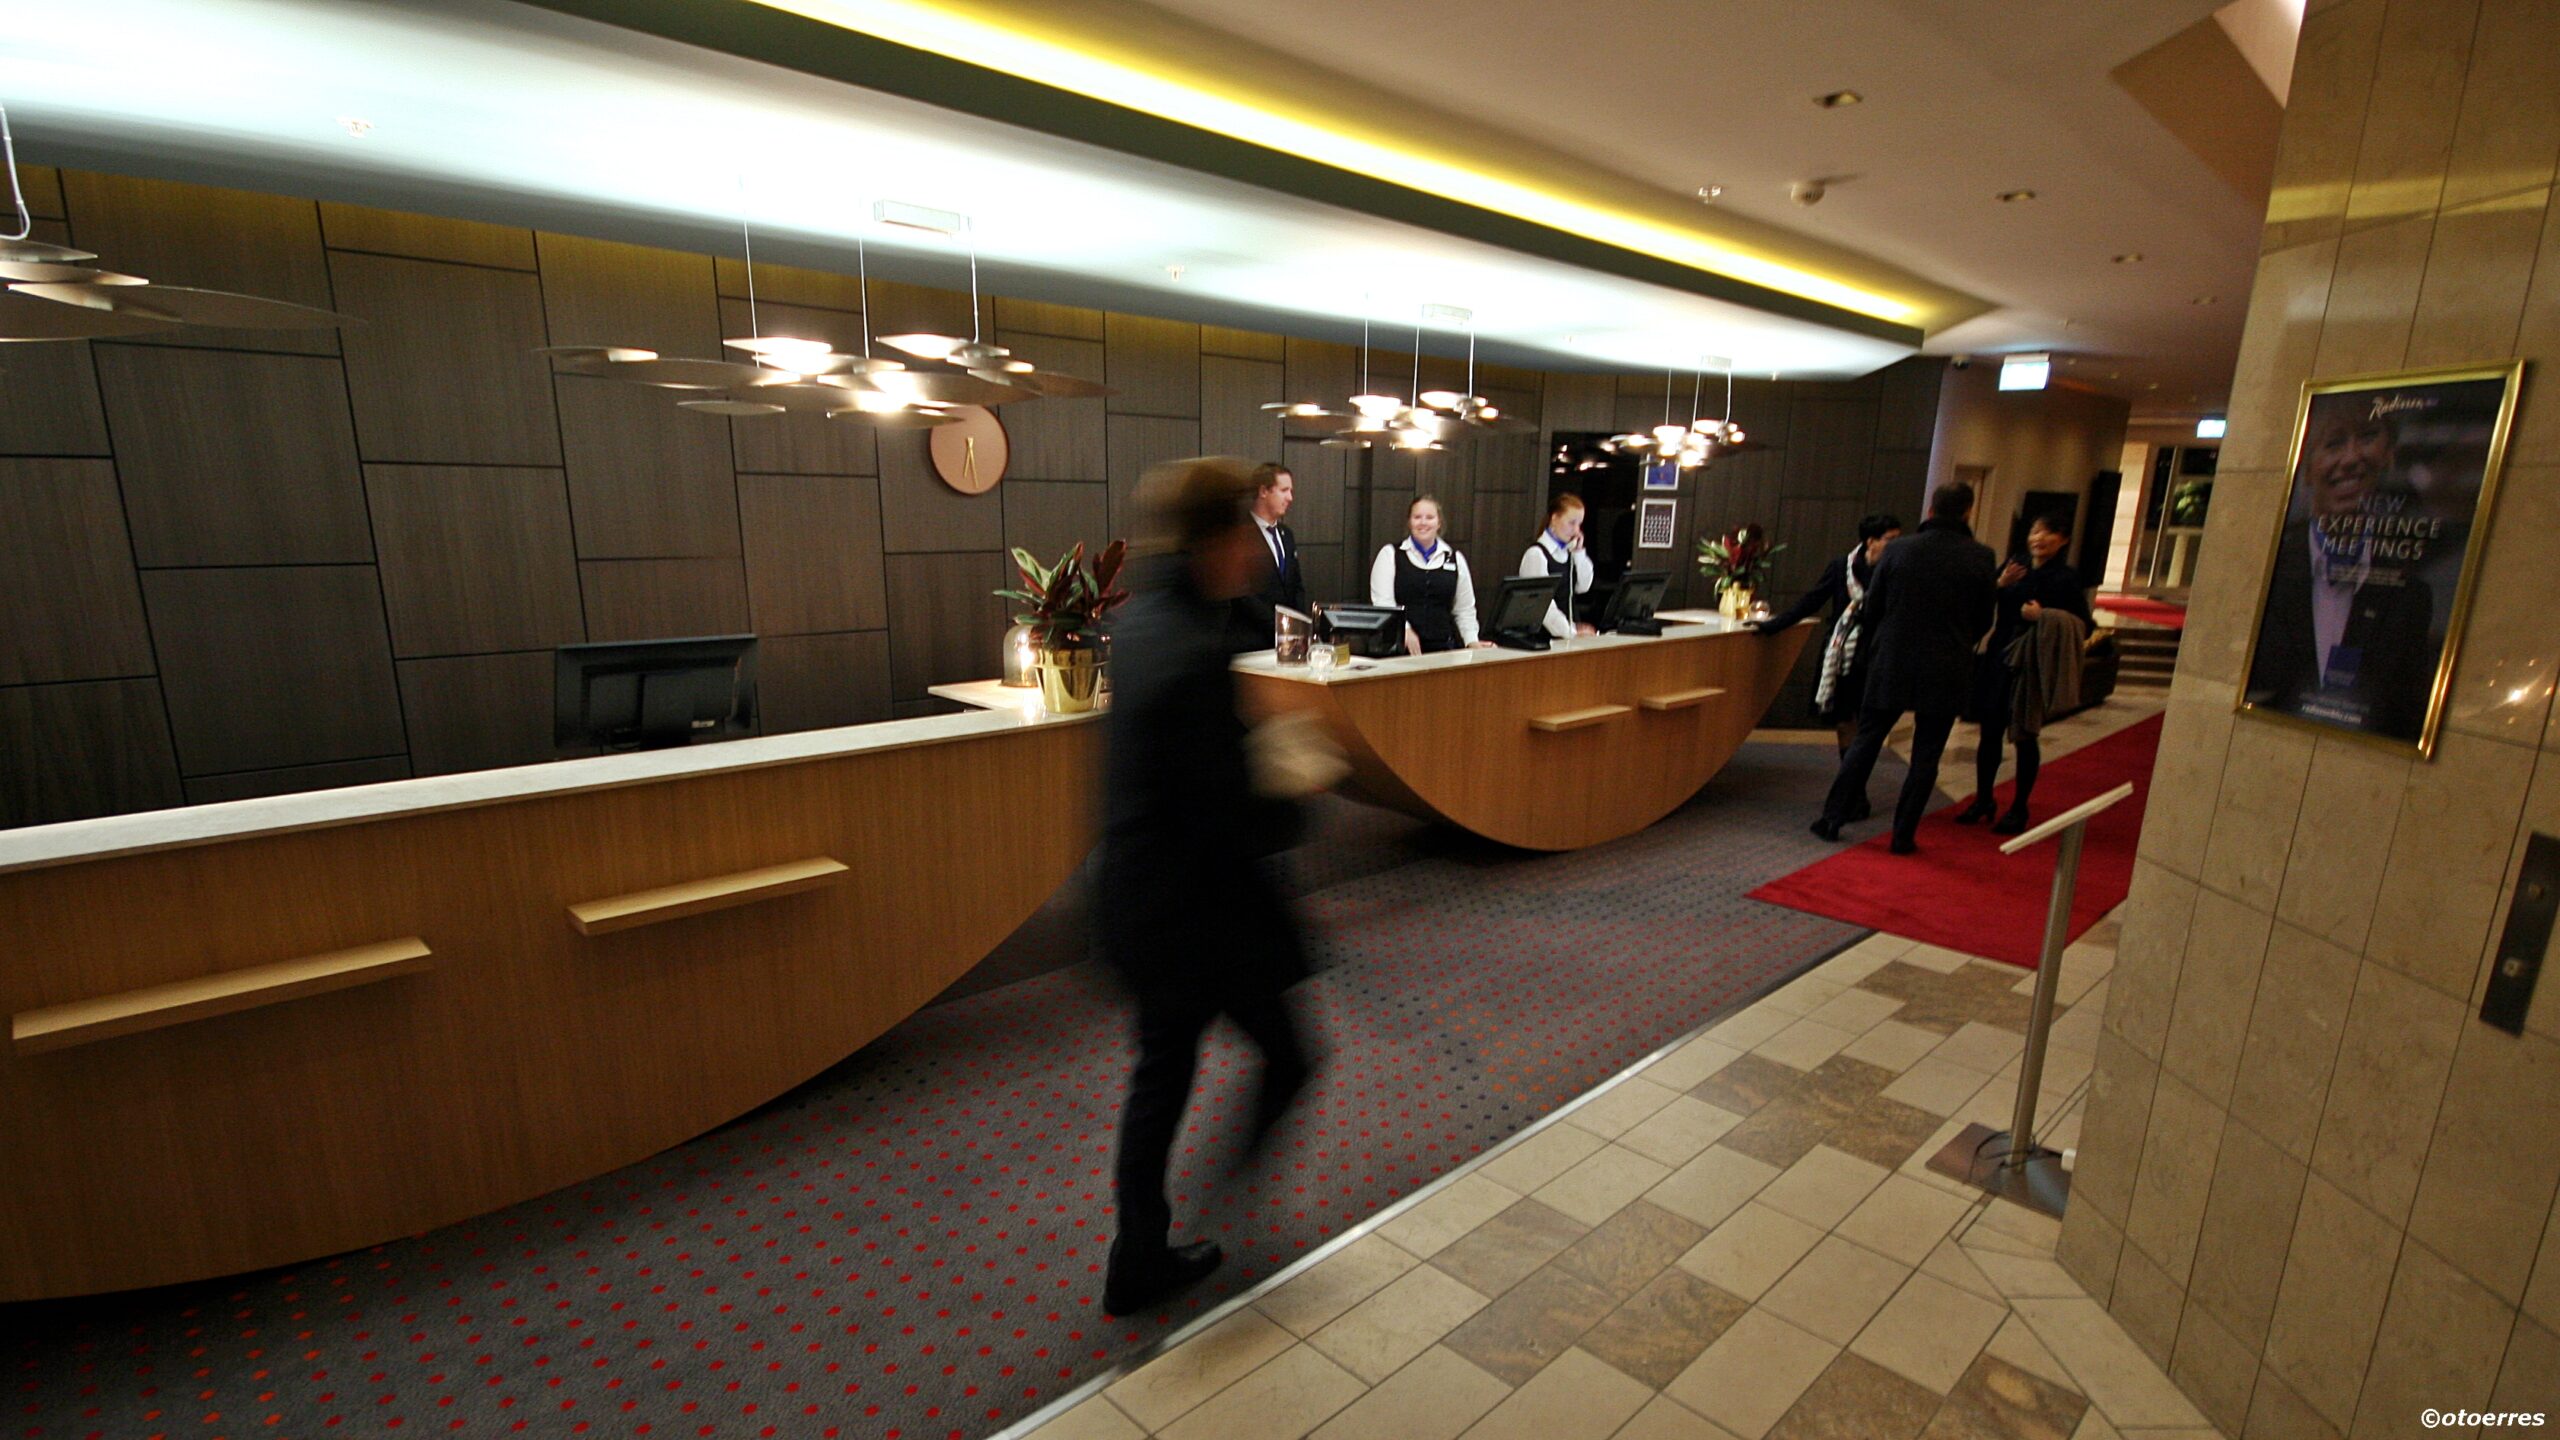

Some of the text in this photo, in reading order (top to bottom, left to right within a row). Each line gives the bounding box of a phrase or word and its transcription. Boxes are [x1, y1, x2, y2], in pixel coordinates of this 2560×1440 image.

[2357, 494, 2408, 513] NEW
[2317, 514, 2442, 539] EXPERIENCE
[2322, 535, 2424, 560] MEETINGS
